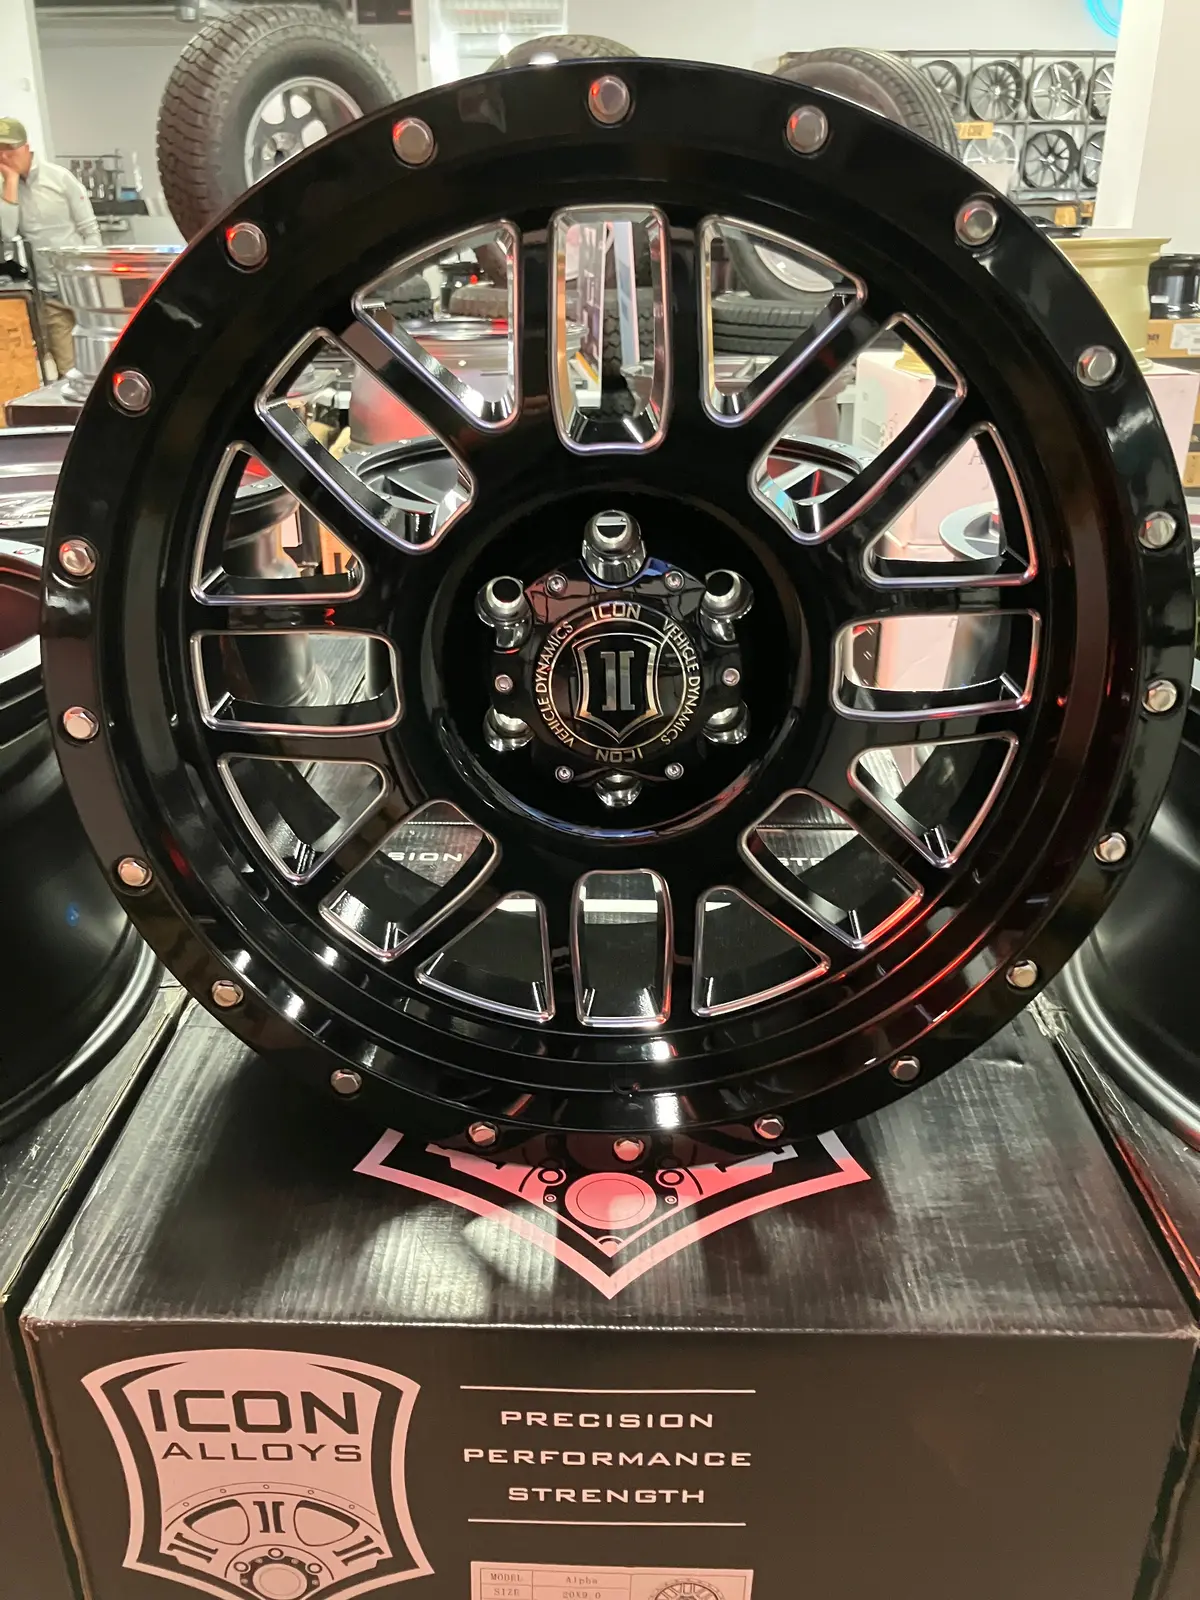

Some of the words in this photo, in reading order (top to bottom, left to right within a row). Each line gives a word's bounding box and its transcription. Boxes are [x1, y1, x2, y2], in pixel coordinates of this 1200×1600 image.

[590, 602, 641, 621] ICON
[663, 616, 699, 672] VEHICLE
[535, 620, 574, 694] DYNAMICS
[661, 675, 701, 746] DYNAMICS
[536, 697, 574, 748] VEHICLE
[595, 747, 644, 763] ICON
[147, 1388, 360, 1435] ICON
[500, 1410, 713, 1428] PRECISION
[161, 1441, 362, 1463] ALLOYS
[463, 1448, 752, 1467] PERFORMANCE
[508, 1486, 705, 1504] STRENGTH
[490, 1572, 522, 1582] MODEL
[565, 1576, 598, 1585] Alpha
[493, 1588, 520, 1596] SIZE
